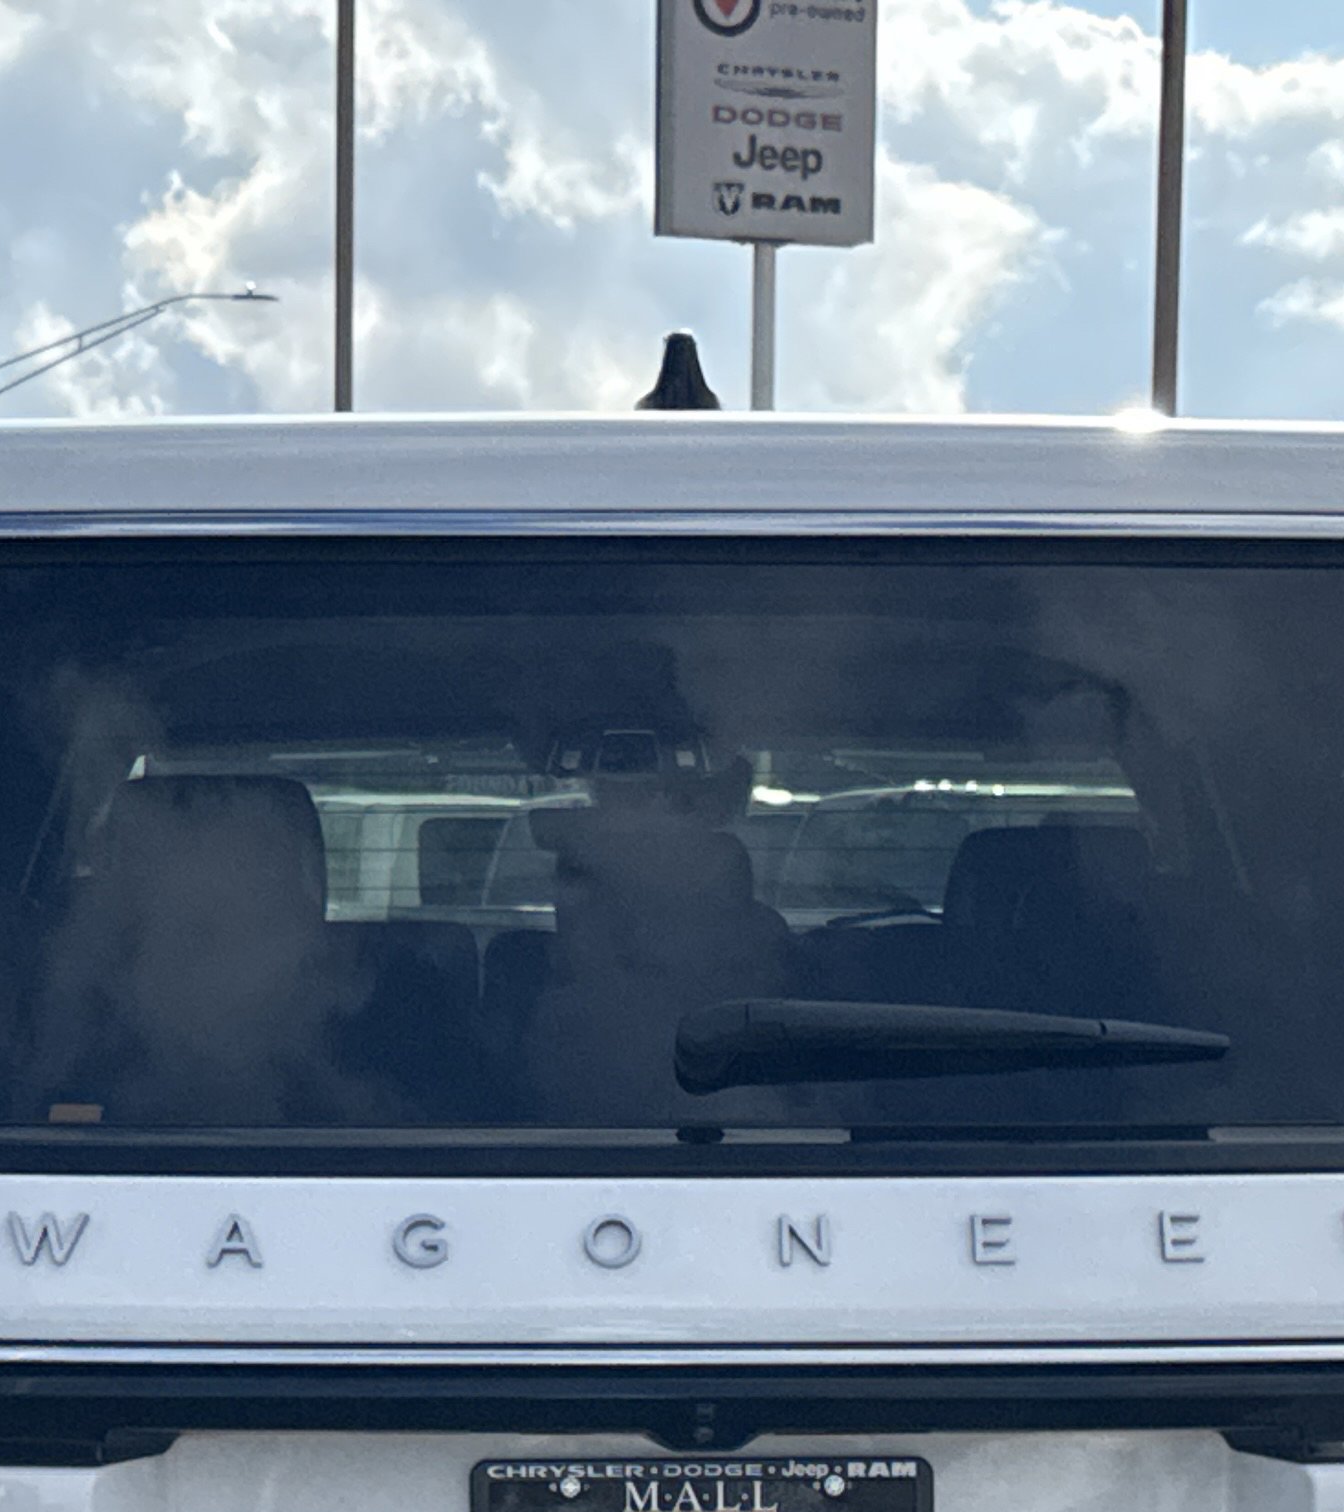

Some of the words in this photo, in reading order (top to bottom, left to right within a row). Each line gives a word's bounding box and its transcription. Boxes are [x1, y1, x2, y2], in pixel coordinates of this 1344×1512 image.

[717, 63, 839, 82] CHRYSLER
[712, 105, 842, 131] DODGE
[733, 135, 823, 180] Jeep
[752, 192, 841, 214] RAM
[487, 1464, 643, 1479] CHRYSLER
[662, 1463, 763, 1478] DODGE
[782, 1460, 828, 1479] Jeep
[847, 1461, 917, 1477] RAM
